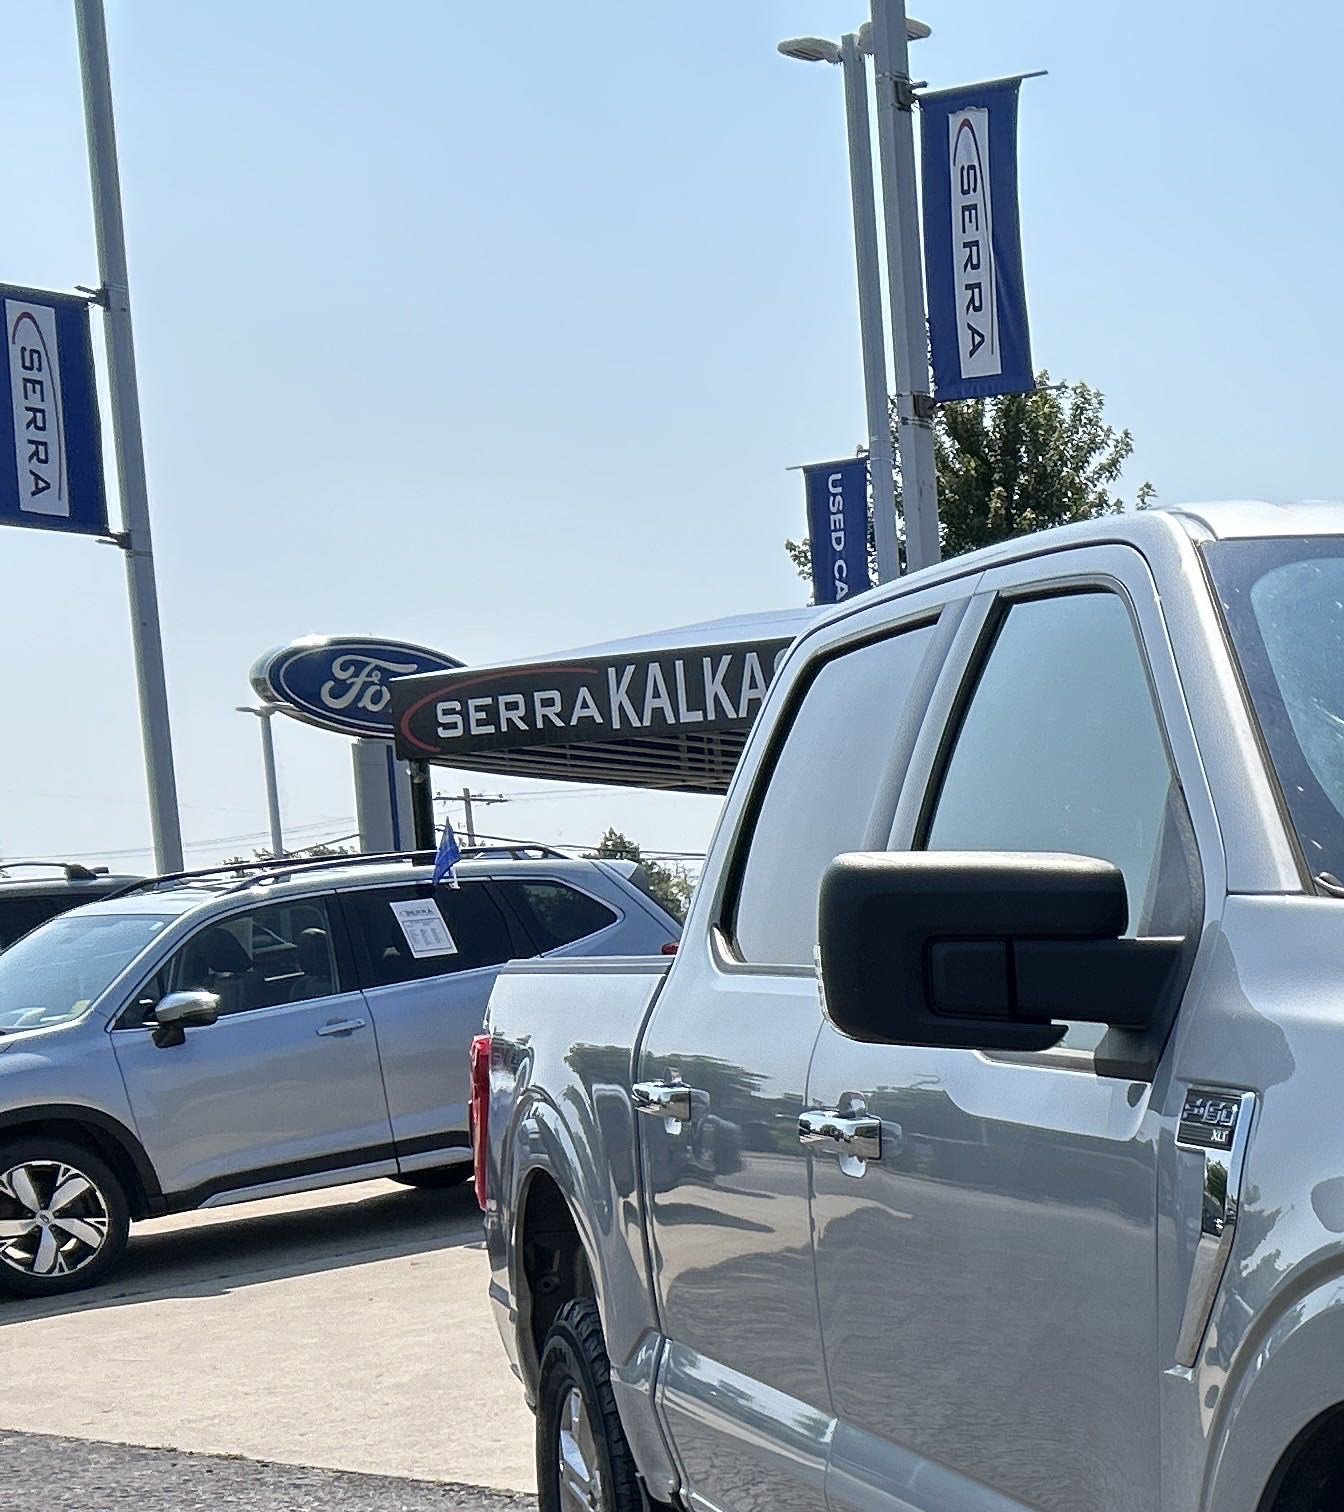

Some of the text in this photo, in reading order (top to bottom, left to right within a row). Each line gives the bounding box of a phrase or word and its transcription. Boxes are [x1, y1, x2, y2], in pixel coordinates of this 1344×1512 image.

[960, 162, 985, 359] SERRA
[20, 346, 51, 497] SERRA
[828, 473, 845, 551] USED
[320, 654, 418, 712] Fo
[437, 648, 790, 739] SERRA KALKA
